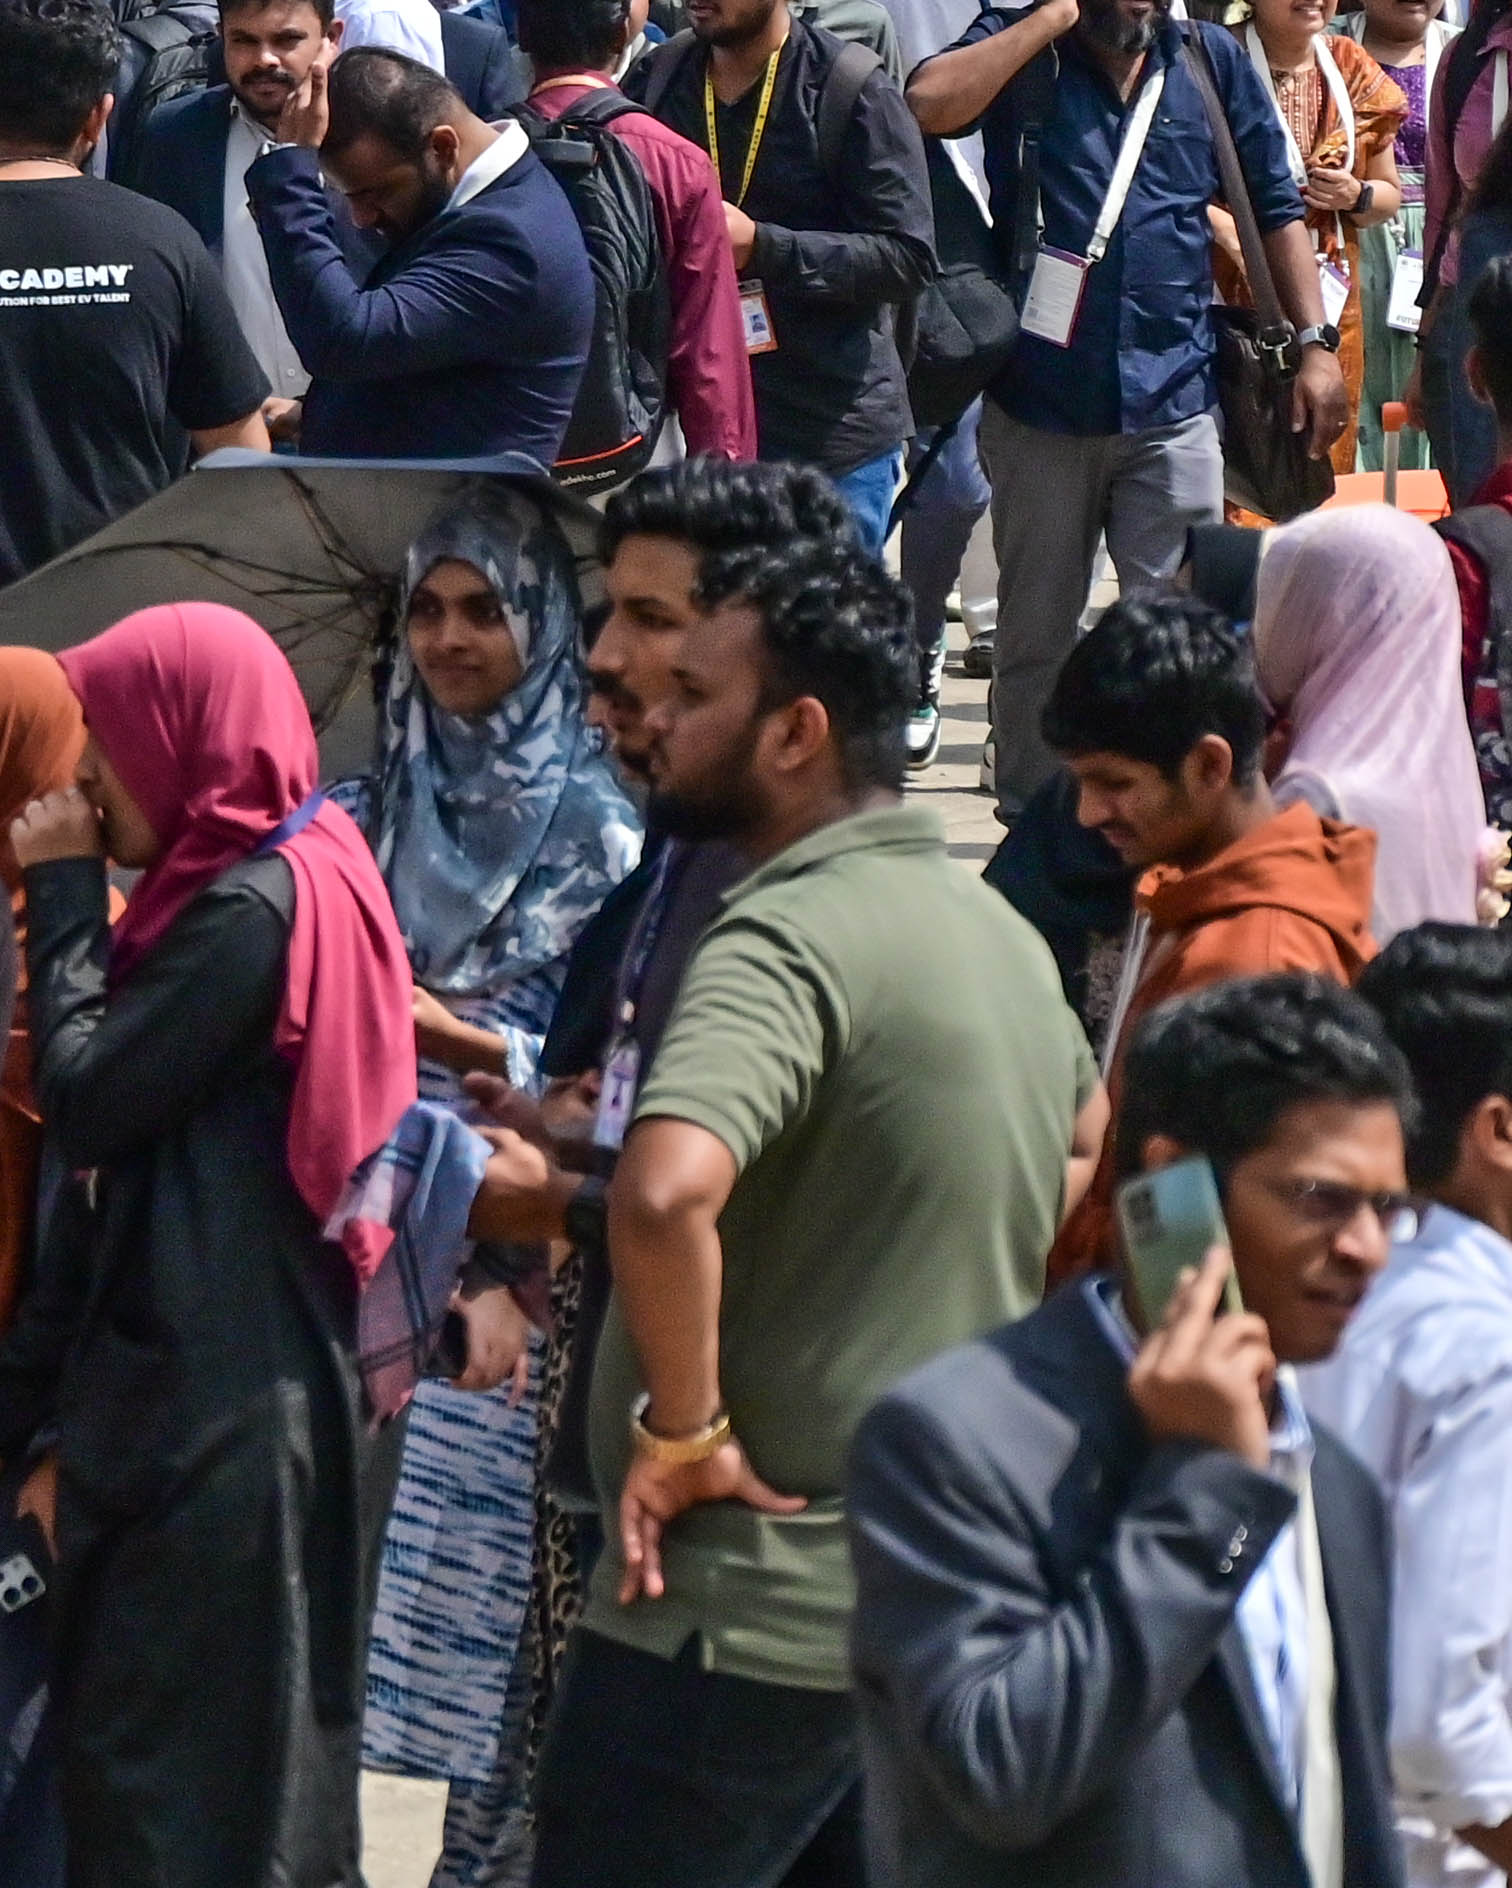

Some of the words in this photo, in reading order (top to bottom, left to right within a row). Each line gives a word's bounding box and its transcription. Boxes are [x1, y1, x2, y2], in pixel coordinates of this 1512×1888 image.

[29, 296, 50, 306] FOR
[51, 295, 77, 305] BEST
[78, 294, 92, 304] EV
[93, 293, 131, 304] TALENT
